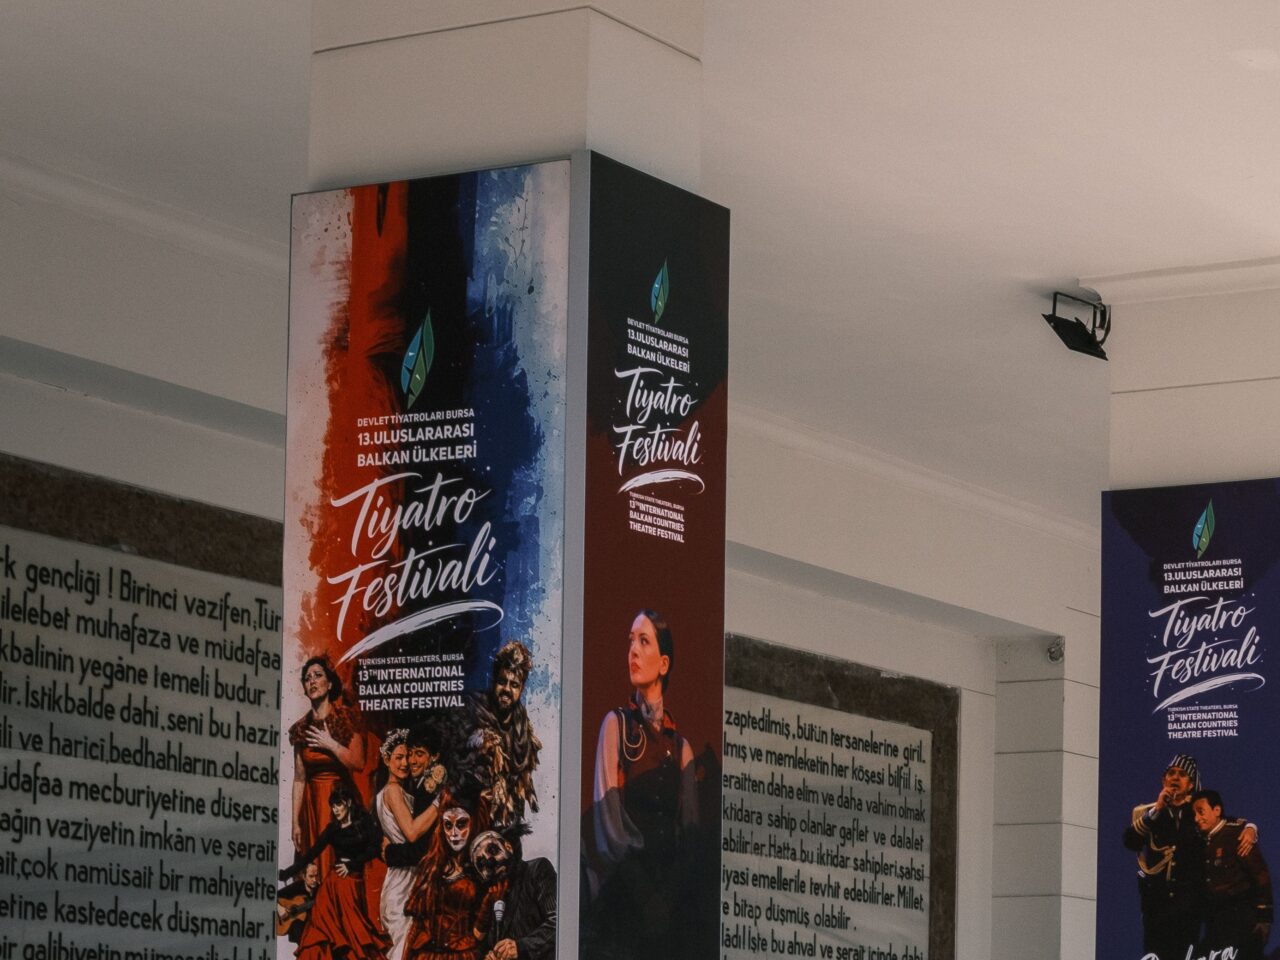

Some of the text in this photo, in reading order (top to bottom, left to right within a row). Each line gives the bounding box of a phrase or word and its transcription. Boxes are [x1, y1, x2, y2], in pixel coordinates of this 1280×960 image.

[627, 344, 690, 373] BALKAN ÜLKELERİ
[615, 366, 698, 424] Tiyatro
[358, 409, 474, 427] DEVLET TİYATROLARI BURSA
[358, 423, 474, 446] 13.ULUSLARARASI
[358, 440, 477, 467] BALKAN ÜLKELERİ
[613, 421, 701, 476] Festivali
[330, 472, 492, 559] Tiyatro
[629, 511, 684, 532] BALKAN COUNTRIES
[629, 521, 684, 543] THEATRE FESTIVAL
[26, 560, 100, 605] gençliği
[120, 569, 177, 610] Birinci
[327, 521, 500, 641] Festivali
[1164, 577, 1244, 593] BALKAN ÜLKELERİ
[1148, 597, 1256, 648] Tiyatro
[77, 608, 170, 654] muhafaza
[177, 634, 199, 654] ve
[205, 634, 280, 676] müdafaa
[442, 653, 464, 662] BURSA
[154, 665, 208, 697] temeli
[1147, 626, 1262, 698] Festivali
[25, 675, 115, 720] İstikbalde
[167, 713, 203, 735] seni
[210, 707, 231, 739] bu
[359, 680, 464, 696] BALKAN COUNTRIES
[359, 692, 464, 711] THEATRE FESTIVAL
[797, 715, 898, 757] bütün tersanelerine
[1168, 720, 1238, 729] BALKAN COUNTRIES
[1168, 729, 1238, 739] THEATRE FESTIVAL
[19, 735, 43, 752] ve
[222, 752, 279, 786] olacak
[749, 746, 911, 795] ve memleketin her köşesi bilfiil
[69, 773, 206, 819] mecburiyetine
[767, 772, 925, 823] daha elim ve daha vahim olmak
[46, 818, 134, 852] vaziyetin
[140, 820, 195, 853] imkân
[201, 838, 222, 856] ve
[768, 805, 924, 852] sahip olanlar gaflet ve dalalet
[769, 834, 796, 860] Hatta
[800, 839, 814, 863] bu
[817, 842, 850, 868] iktidar
[65, 861, 154, 889] namüsait
[160, 860, 184, 891] bir
[189, 866, 276, 908] mahiyette
[753, 866, 805, 893] emellerile
[810, 874, 840, 898] tevhit
[55, 890, 163, 932] kastedecek
[734, 892, 761, 926] bitap
[766, 897, 810, 928] düşmüş
[748, 926, 767, 953] İşte
[772, 929, 784, 952] bu
[787, 931, 816, 957] ahval
[820, 945, 833, 958] ve
